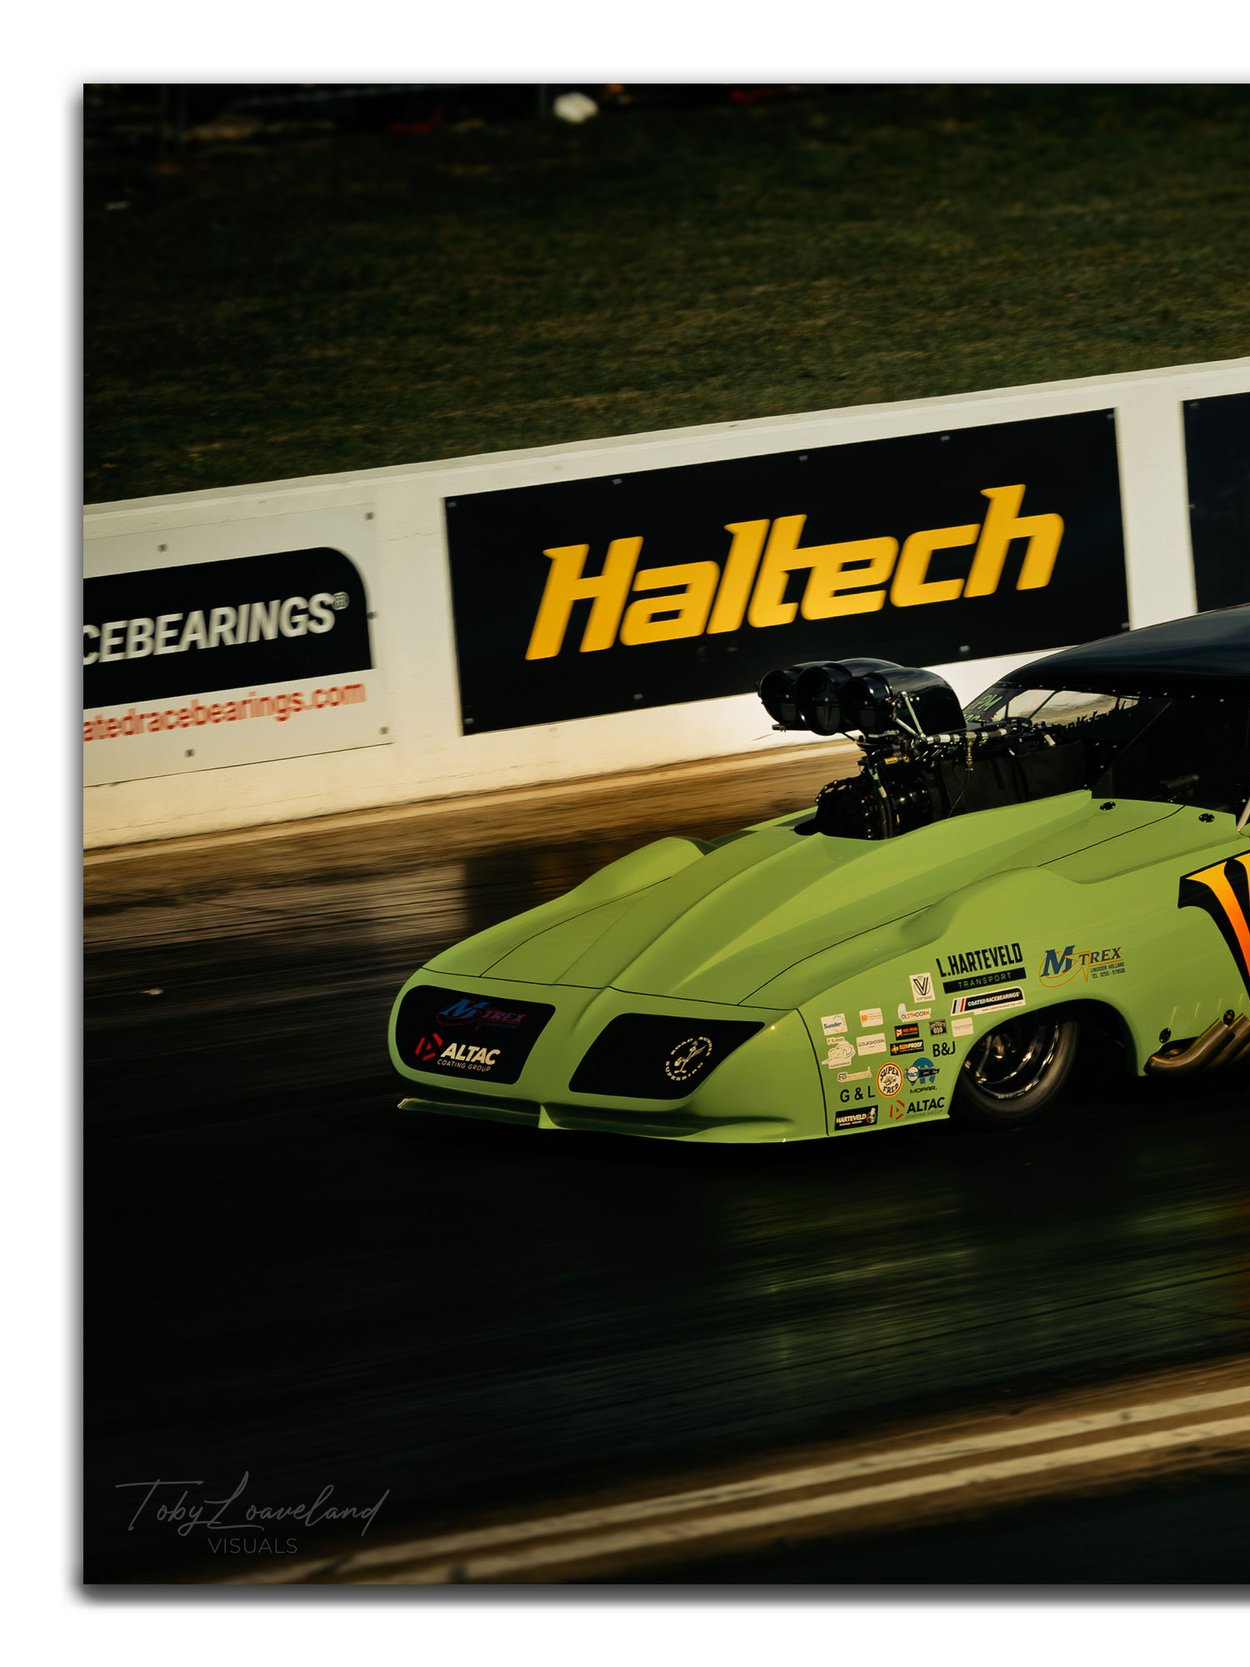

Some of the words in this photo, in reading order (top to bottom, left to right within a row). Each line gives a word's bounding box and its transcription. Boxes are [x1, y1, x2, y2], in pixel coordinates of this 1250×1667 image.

[525, 484, 1064, 660] Haltech
[935, 942, 1023, 978] L.HARTEVELD
[1079, 946, 1122, 966] TREX
[958, 972, 1012, 989] TRANSPORT
[440, 1042, 502, 1066] ALTAC
[932, 1041, 956, 1058] B&J
[437, 1058, 467, 1070] COATING
[467, 1063, 491, 1073] GROUP
[880, 1065, 900, 1081] SUPER
[840, 1088, 850, 1103] G
[854, 1086, 864, 1101] &
[867, 1085, 876, 1099] L
[882, 1083, 900, 1095] FRED
[906, 1096, 945, 1115] ALTAC
[835, 1112, 867, 1125] HARTEVELD
